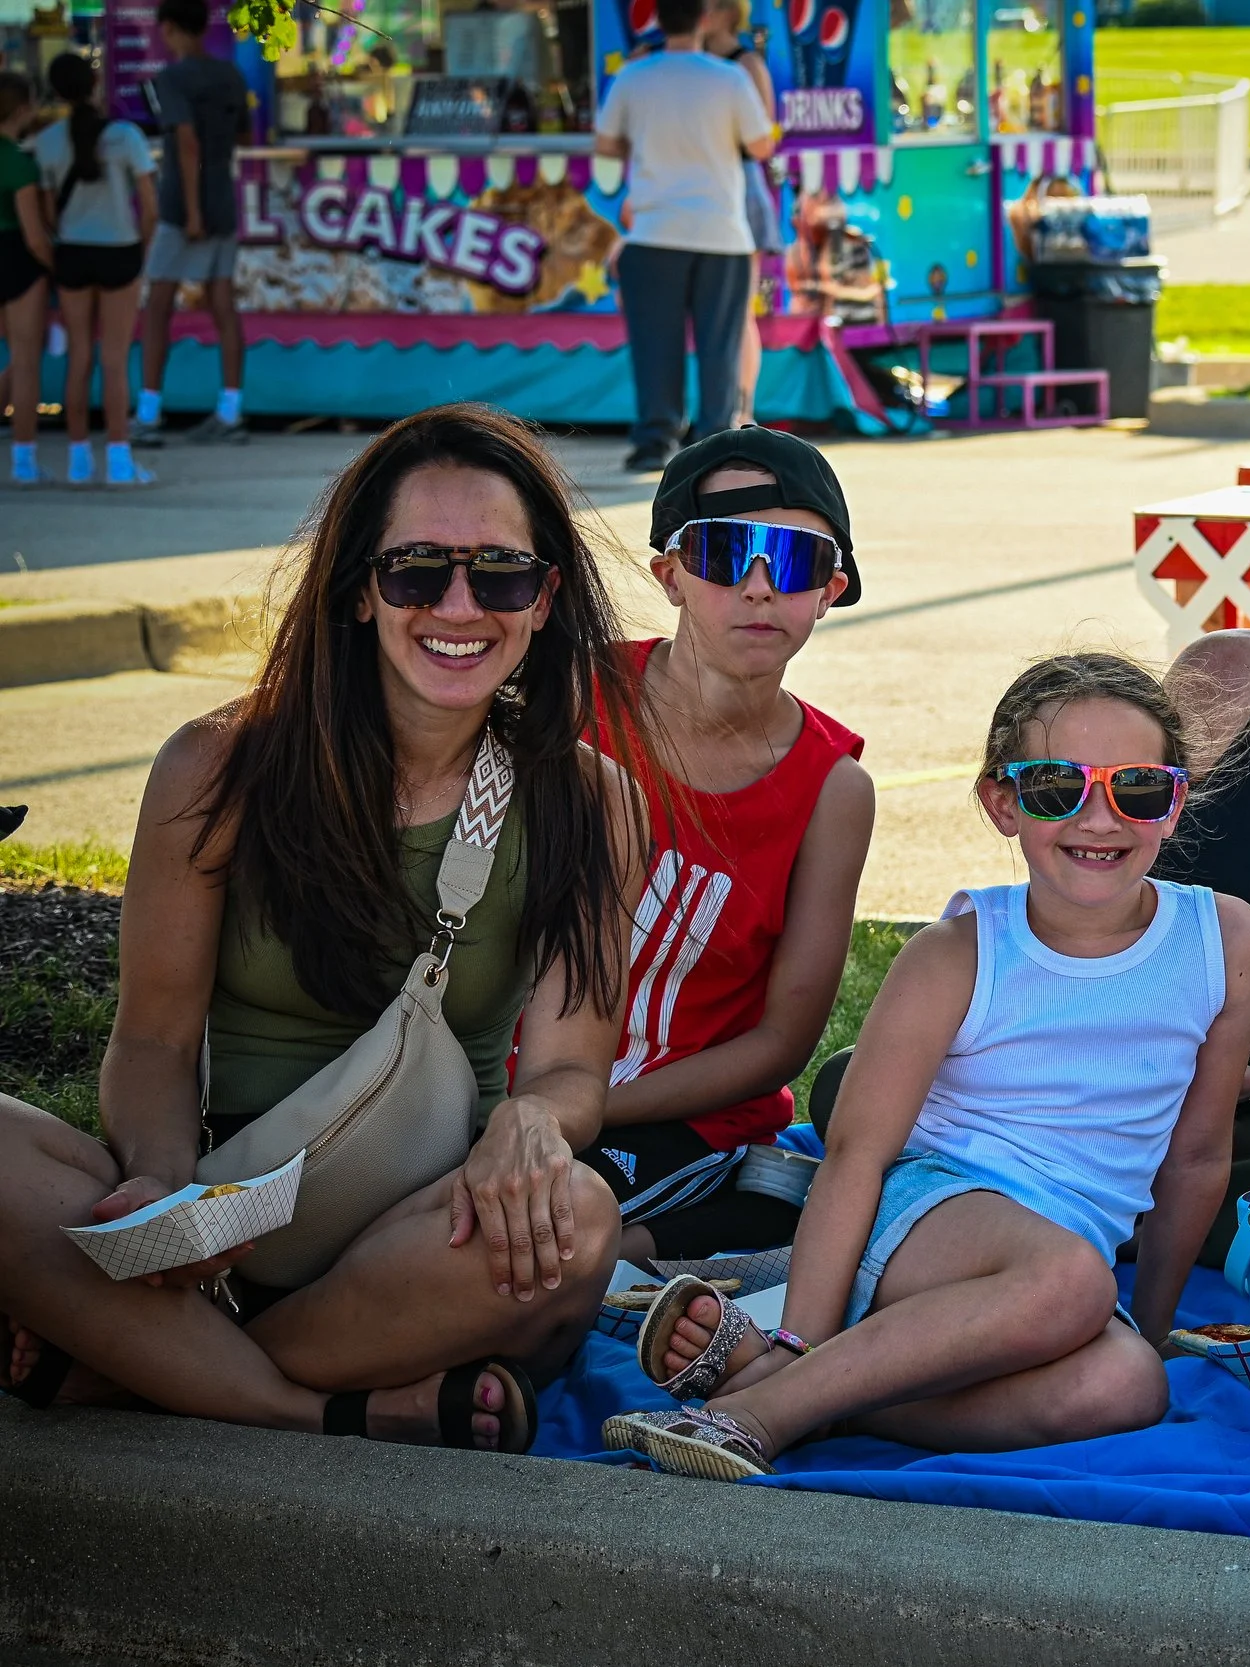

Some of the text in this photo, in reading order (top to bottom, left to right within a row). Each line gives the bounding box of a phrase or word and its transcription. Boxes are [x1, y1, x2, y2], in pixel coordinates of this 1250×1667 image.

[781, 88, 863, 131] DRINKS
[303, 182, 541, 290] CAKES
[600, 1147, 636, 1185] adidas
